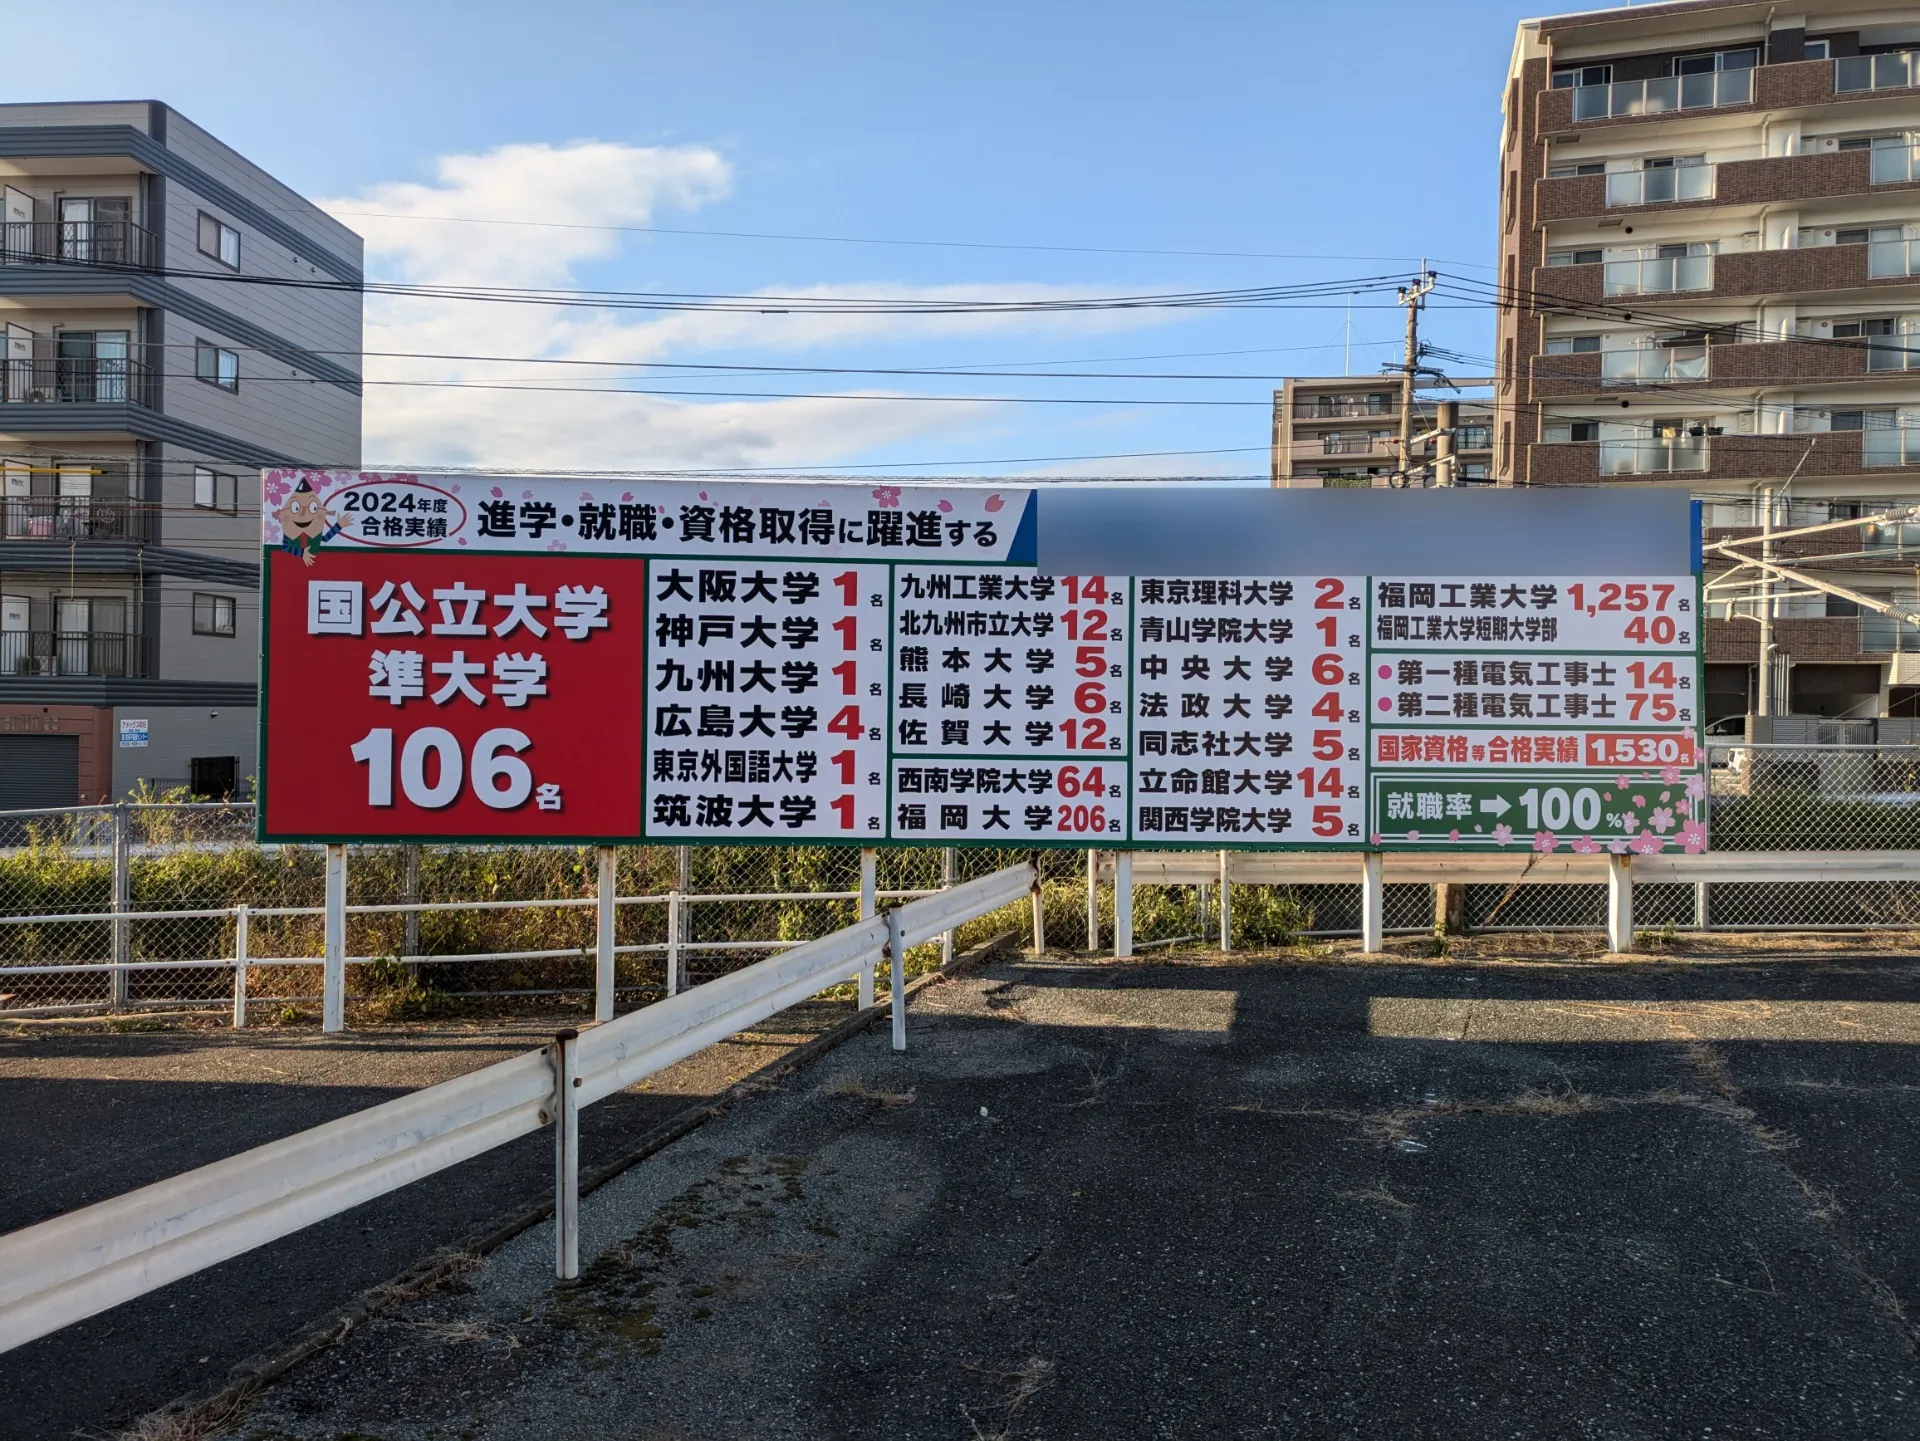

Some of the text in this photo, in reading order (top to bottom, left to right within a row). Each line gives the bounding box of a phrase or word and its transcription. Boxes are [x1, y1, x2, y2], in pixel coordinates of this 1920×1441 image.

[343, 491, 448, 513] 2024年度
[361, 516, 448, 538] 合格実績
[656, 569, 820, 604] 大阪大学
[900, 573, 1054, 601] 九州工業大学
[1140, 579, 1293, 606] 東京理科大学
[1378, 582, 1558, 609] 福岡工業大学
[307, 580, 608, 639] 国公立大学
[899, 610, 1054, 637] 北九州市立大学
[655, 613, 819, 649] 神戸大学
[1140, 616, 1293, 644] 青山学院大学
[1377, 615, 1558, 642] 福岡工業大学短期大学部
[899, 646, 1054, 674] 熊本大学
[1140, 654, 1293, 682] 中央大学
[1397, 659, 1616, 687] 第一種電気工事士
[368, 650, 547, 707] 準大学
[655, 658, 819, 694] 九州大学
[899, 683, 1054, 710] 長崎大学
[1139, 692, 1293, 720] 法政大学
[1397, 692, 1616, 719] 第二種電気工事士
[654, 703, 818, 739] 広島大学
[899, 719, 1053, 746] 佐賀大学
[1139, 730, 1293, 757] 同志社大学
[1378, 734, 1579, 763] 国家資格等合格実績
[351, 726, 562, 810] 106名
[652, 749, 818, 784] 東京外国語大学
[898, 767, 1052, 794] 西南学院大学
[1139, 767, 1292, 796] 立命館大学
[652, 793, 817, 828] 筑波大学
[898, 803, 1052, 831] 福岡大学
[1139, 806, 1292, 833] 関西学院大学
[1387, 792, 1472, 820] 就職率
